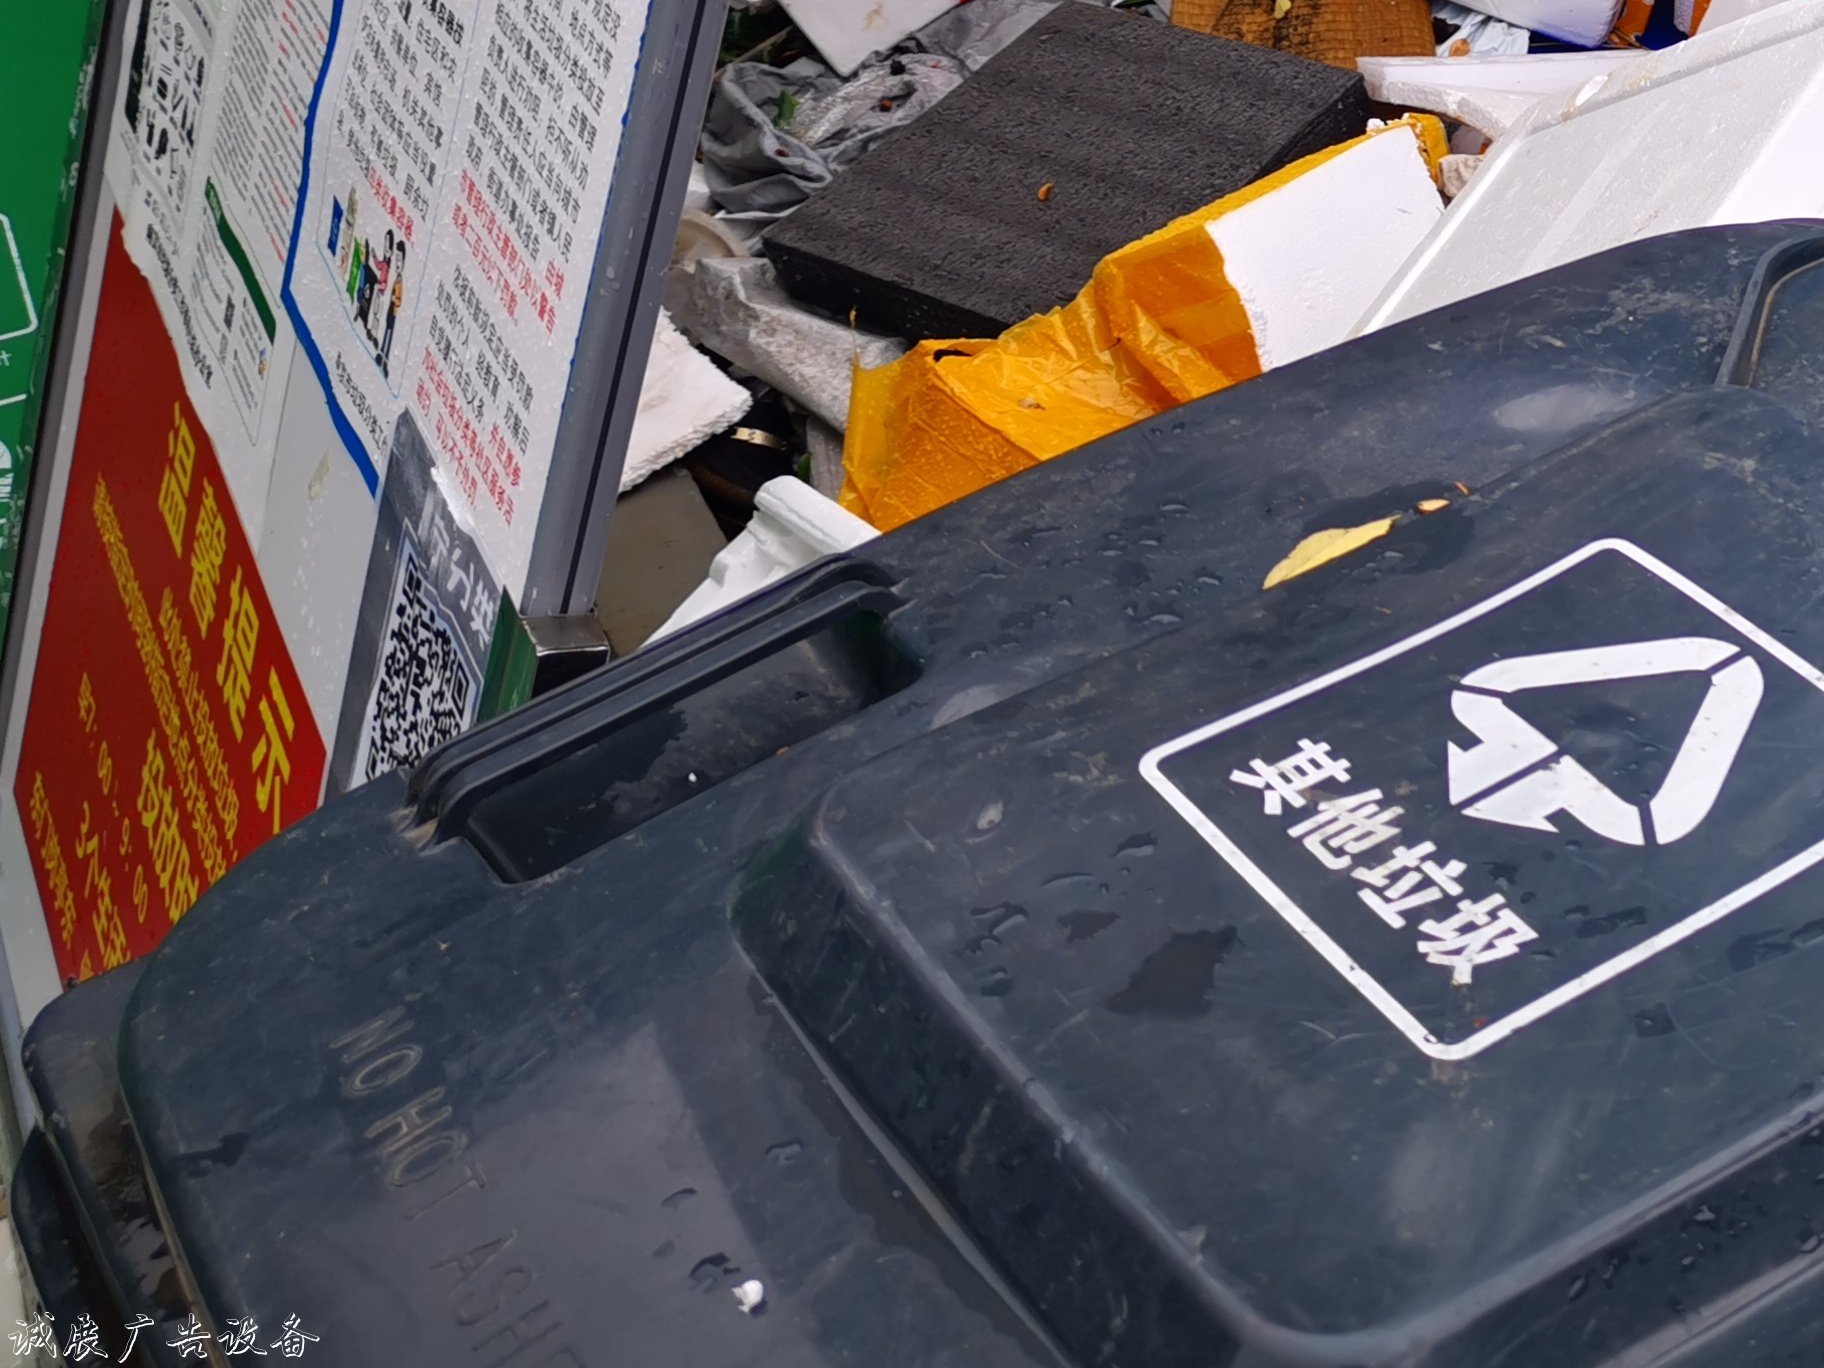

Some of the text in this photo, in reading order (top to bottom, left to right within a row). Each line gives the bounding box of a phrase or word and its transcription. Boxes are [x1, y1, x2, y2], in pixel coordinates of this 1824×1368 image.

[156, 391, 301, 842] 温馨提示
[72, 791, 130, 981] 3个生活
[1229, 737, 1540, 985] 其他垃圾
